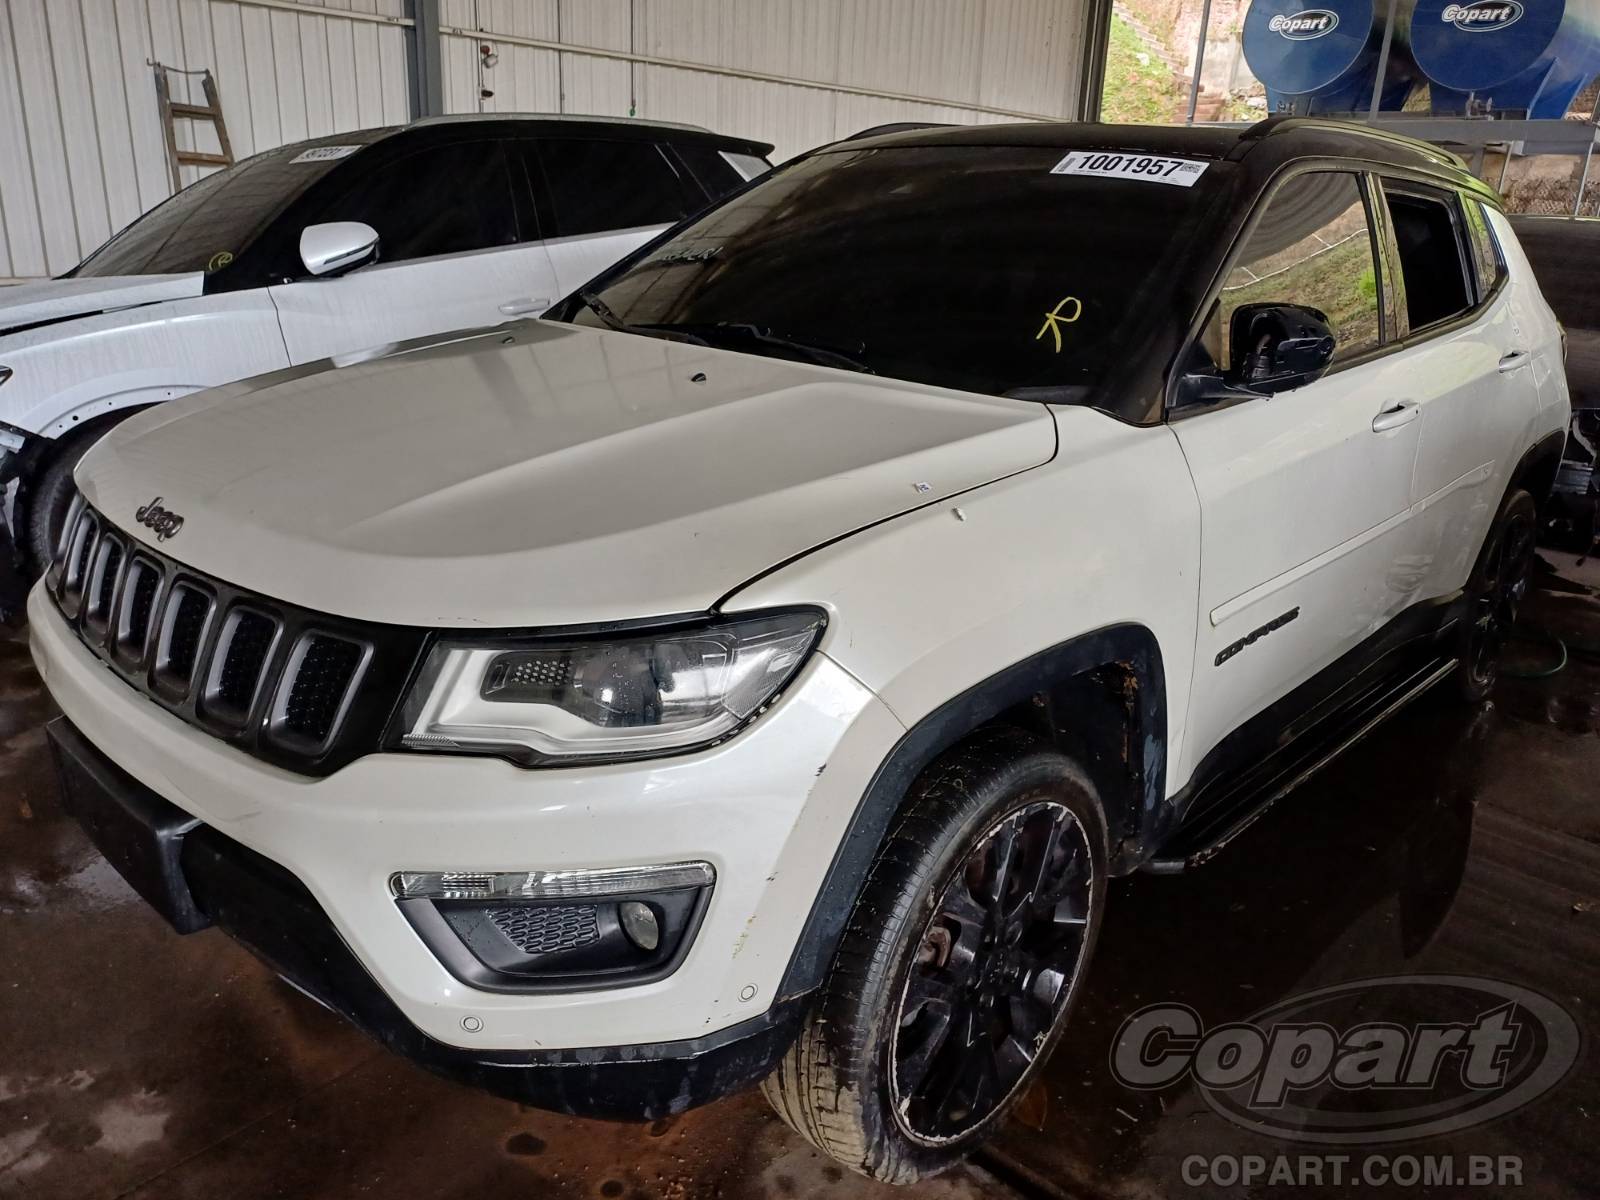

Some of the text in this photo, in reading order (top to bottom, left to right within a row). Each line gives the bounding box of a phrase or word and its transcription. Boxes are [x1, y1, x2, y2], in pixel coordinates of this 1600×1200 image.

[1269, 14, 1330, 33] Copart
[1442, 4, 1512, 25] Copart
[1078, 154, 1184, 177] 1001957
